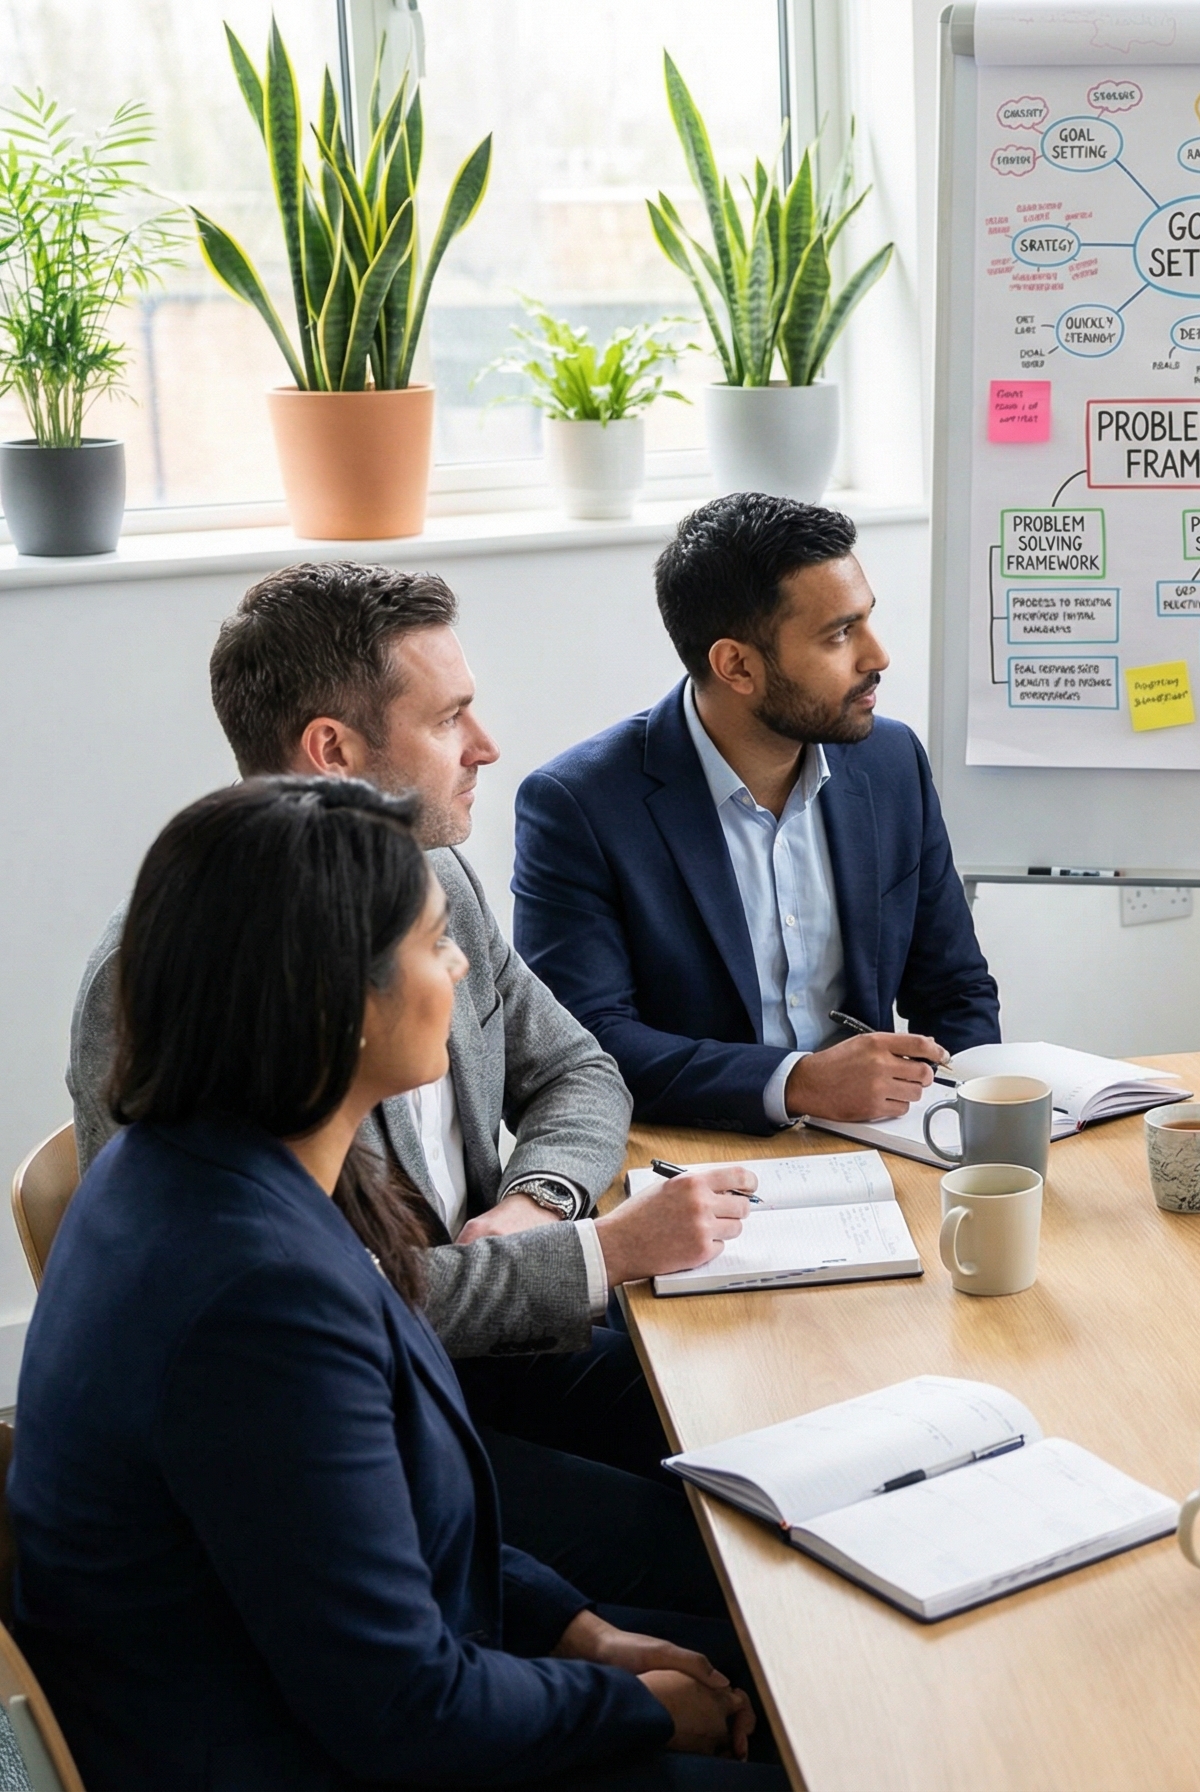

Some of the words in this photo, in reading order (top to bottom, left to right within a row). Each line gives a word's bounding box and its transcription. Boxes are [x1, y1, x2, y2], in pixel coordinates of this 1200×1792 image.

[1059, 128, 1095, 142] GOAL
[1052, 145, 1107, 159] SETTING
[1014, 516, 1084, 532] PROBLEM
[1019, 536, 1082, 551] SOLVING
[1007, 555, 1099, 570] FRAMEWORK
